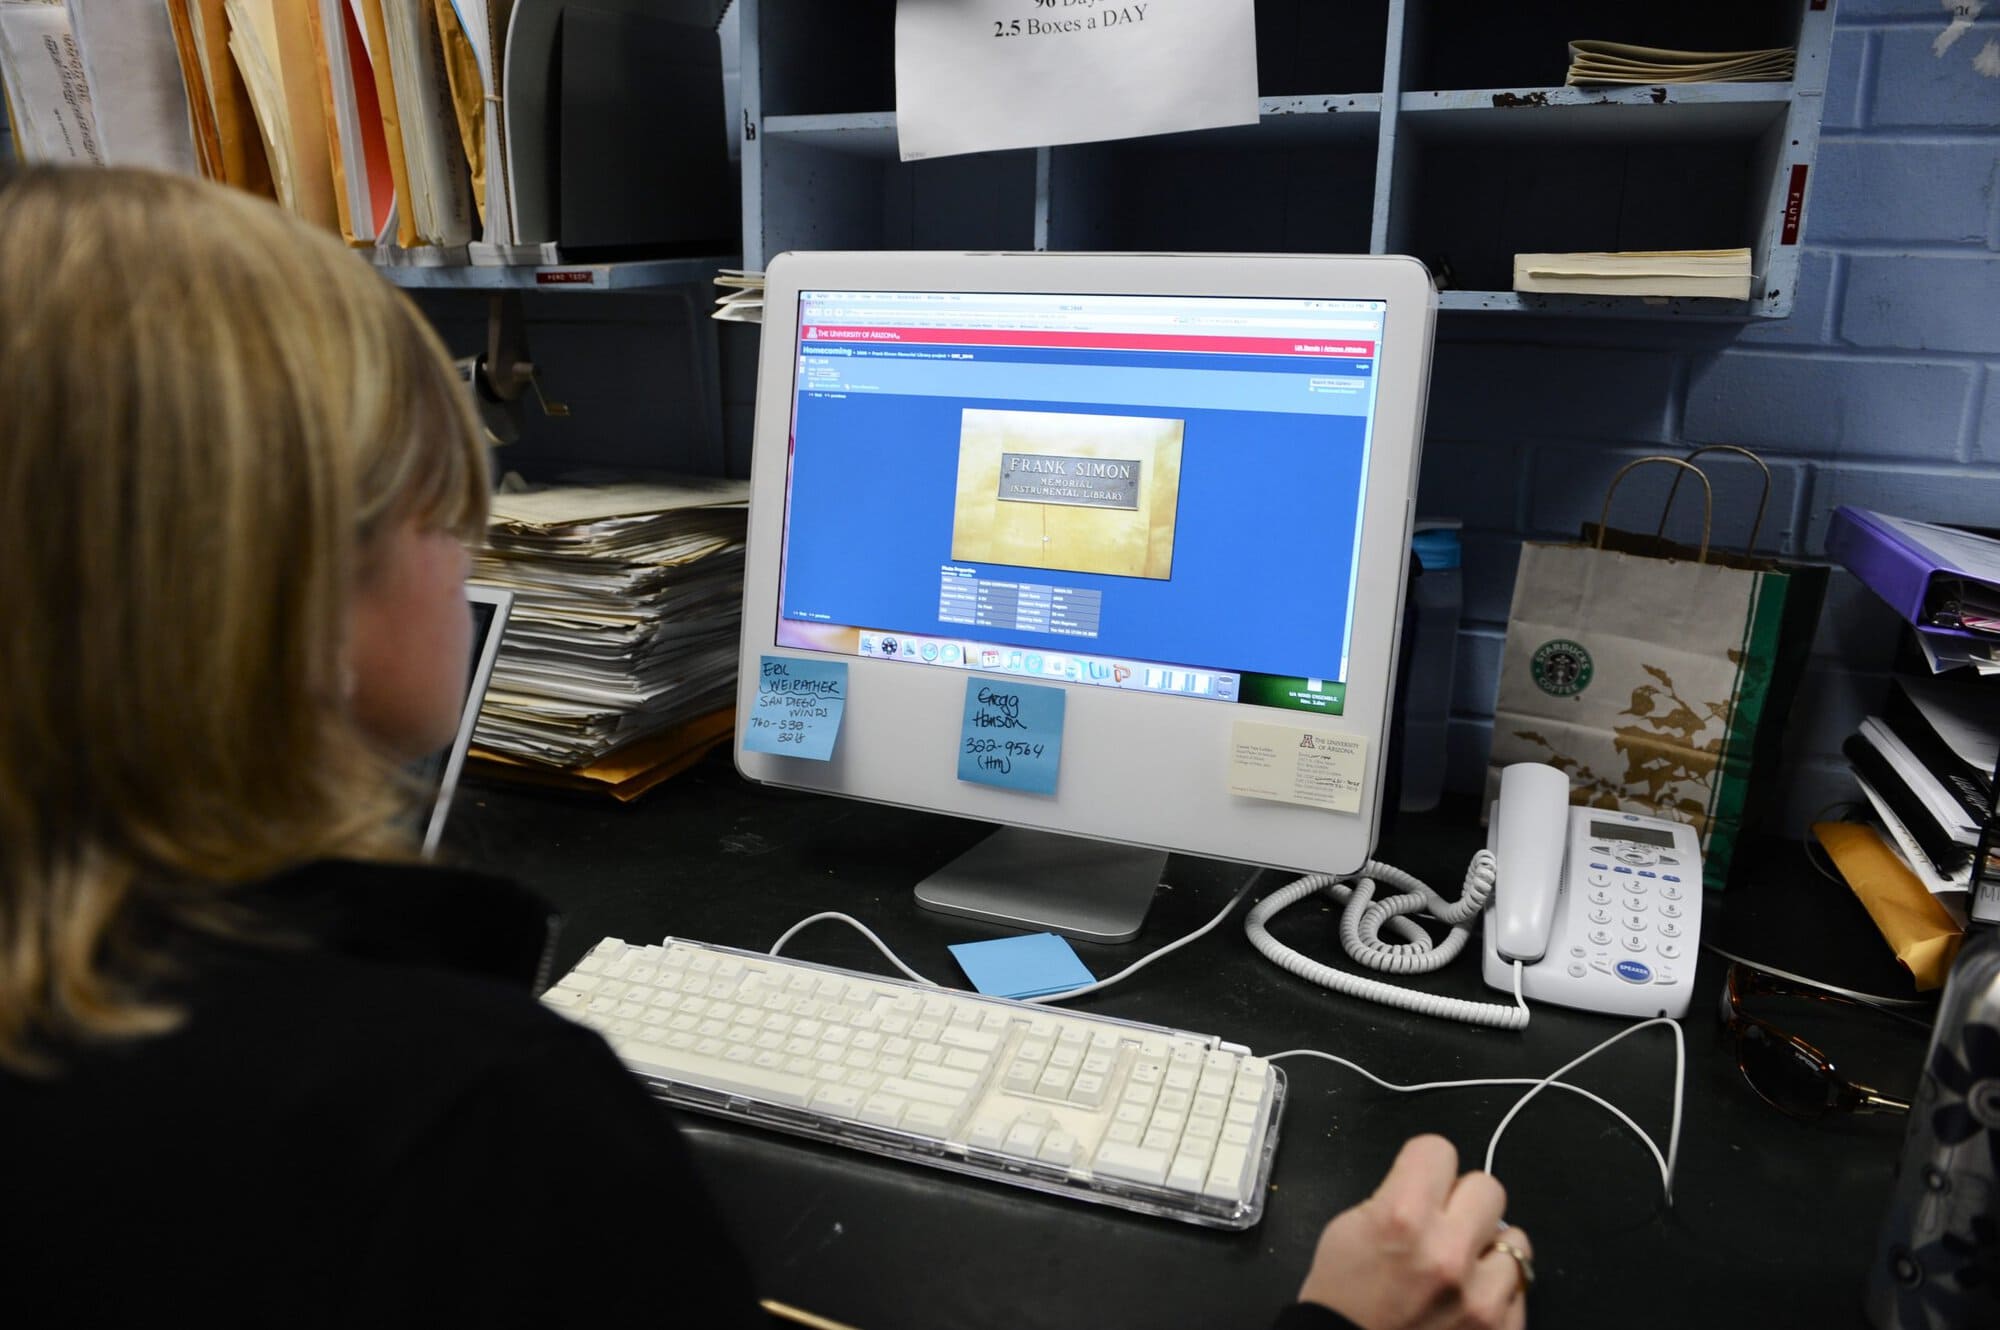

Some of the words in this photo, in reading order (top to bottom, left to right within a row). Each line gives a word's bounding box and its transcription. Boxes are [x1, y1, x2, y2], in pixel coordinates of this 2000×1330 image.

[993, 20, 1021, 37] 2.5
[1027, 18, 1082, 35] Boxes
[1088, 18, 1097, 29] a
[1103, 3, 1149, 27] DAY
[1787, 192, 1800, 230] FLUTE
[829, 330, 861, 338] UNIVERSITY
[803, 346, 852, 357] Homecoming
[1010, 457, 1066, 475] FRANK
[1075, 462, 1131, 479] SIMON
[1040, 478, 1093, 489] MEMORIAL
[1010, 485, 1079, 497] INSTRUMENTAL
[1083, 490, 1123, 501] LIBRARY
[1536, 643, 1590, 670] STARBUCKS
[769, 679, 840, 694] WEIRATHER
[1539, 677, 1579, 694] COFFEE
[760, 696, 782, 707] SAN
[785, 696, 817, 708] DIEGO
[790, 708, 828, 717] WINDS
[966, 737, 1044, 759] 322-9564
[1619, 964, 1650, 976] SPEAKER
